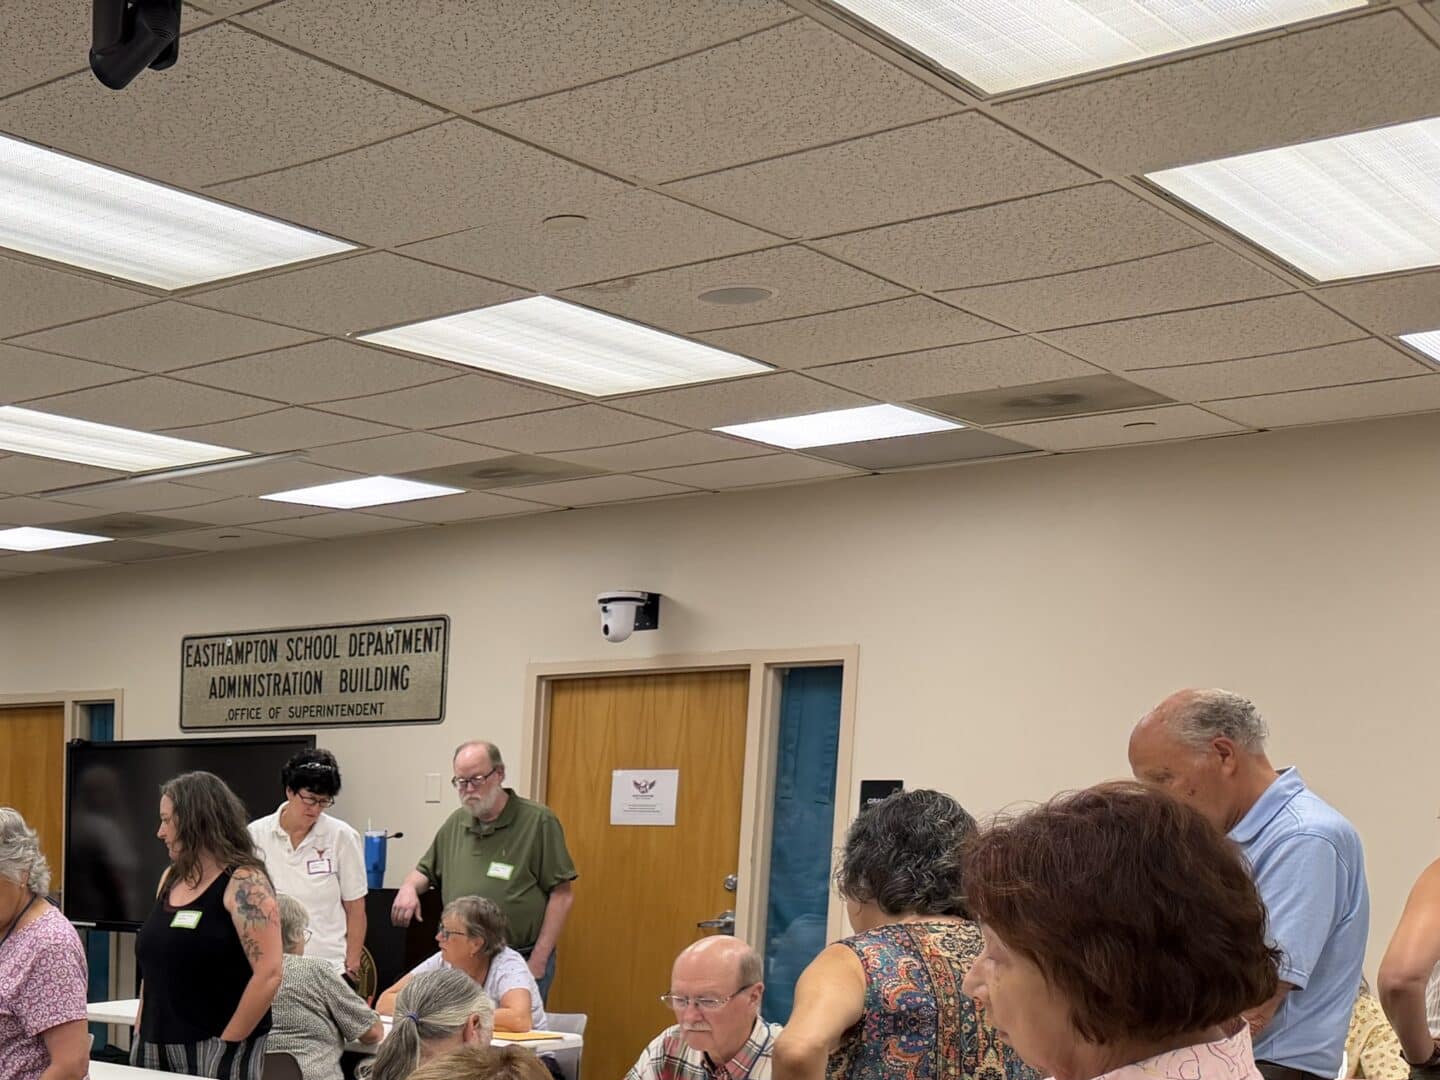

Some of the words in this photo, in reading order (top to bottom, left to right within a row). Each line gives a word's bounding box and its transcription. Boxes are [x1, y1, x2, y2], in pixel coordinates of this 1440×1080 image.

[185, 638, 278, 668] EASTHAMPTON
[286, 633, 340, 661] SCHOOL
[349, 626, 442, 657] DEPARTMENT
[209, 670, 323, 699] ADMINISTRATION
[340, 664, 410, 693] BUILDING
[227, 706, 262, 721] OFFICE
[268, 706, 282, 719] OF
[288, 702, 385, 719] SUPERINTENDENT
